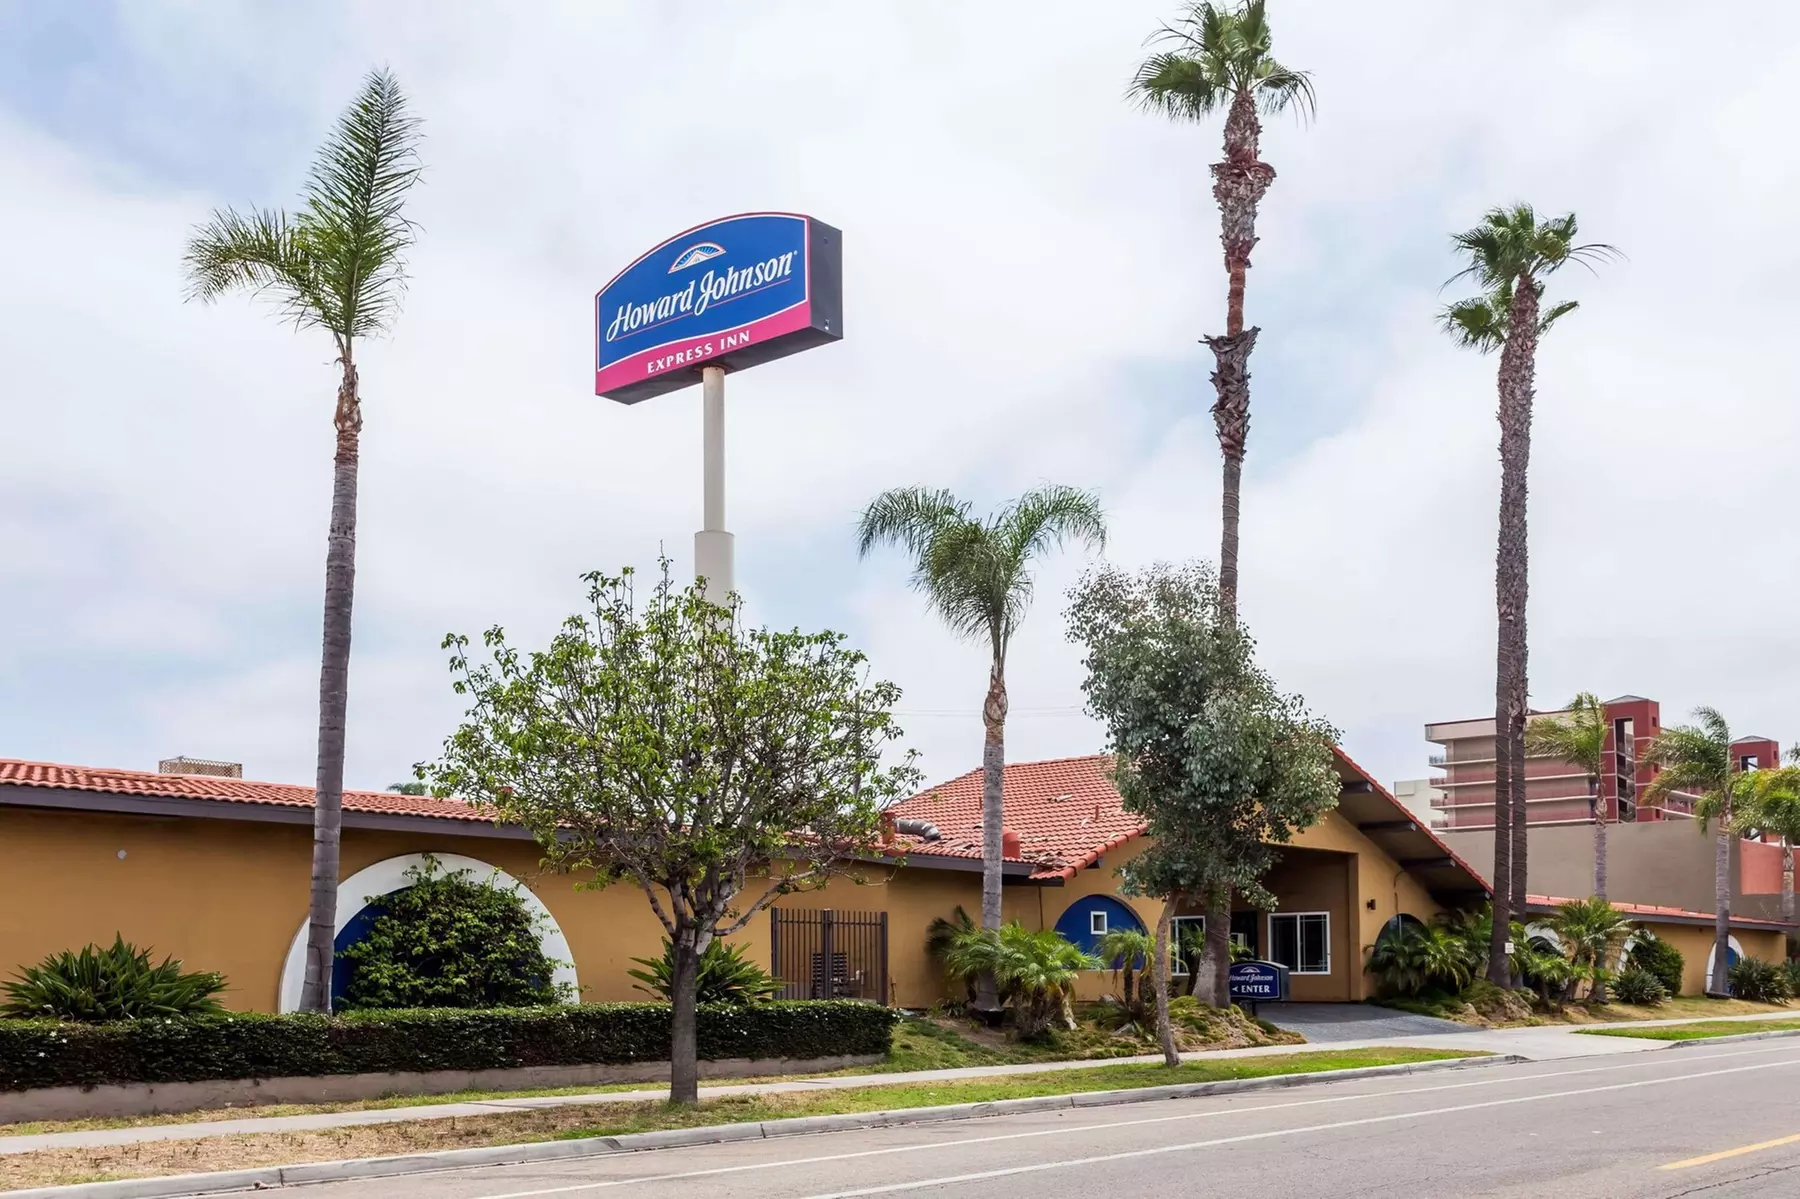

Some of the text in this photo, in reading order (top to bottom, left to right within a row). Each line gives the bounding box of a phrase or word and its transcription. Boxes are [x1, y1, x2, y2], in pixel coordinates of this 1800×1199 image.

[606, 251, 794, 342] Howard Johnson
[647, 330, 751, 374] EXPRESS INN
[1241, 984, 1271, 993] ENTER
[1249, 973, 1274, 983] Johnson
